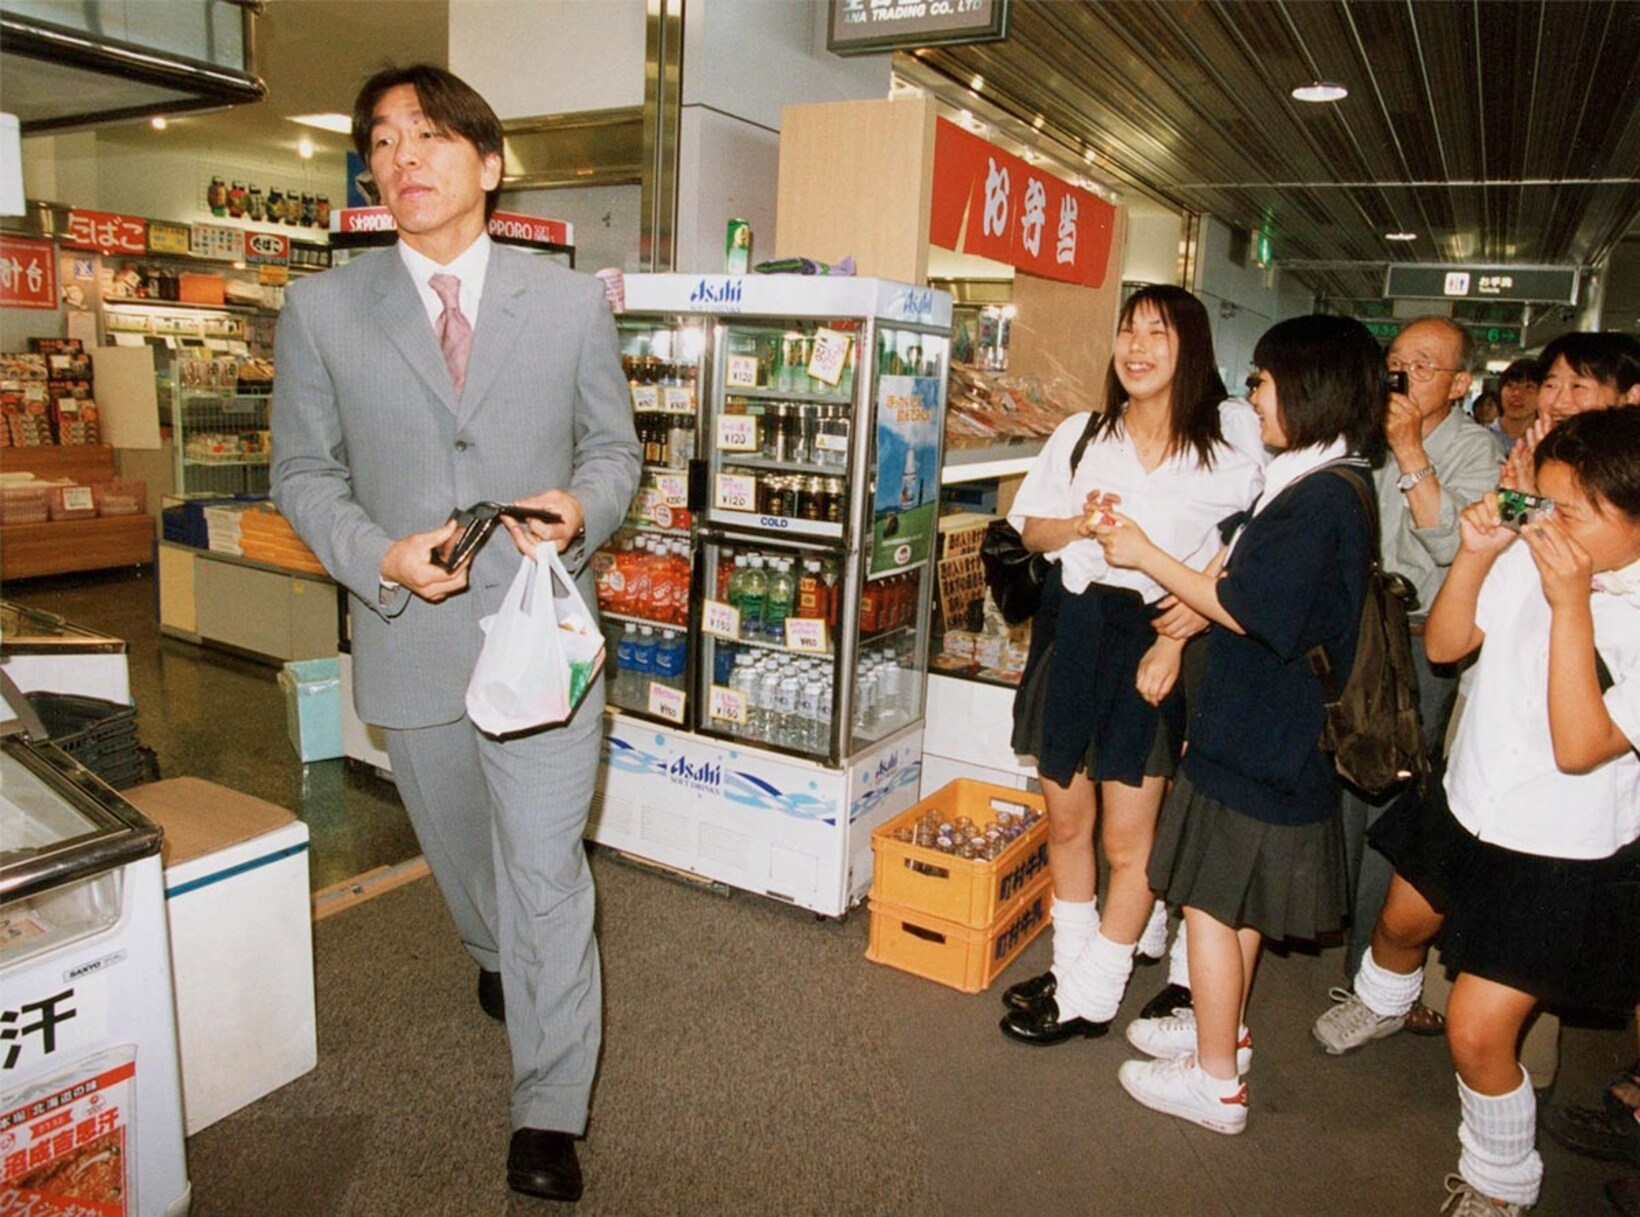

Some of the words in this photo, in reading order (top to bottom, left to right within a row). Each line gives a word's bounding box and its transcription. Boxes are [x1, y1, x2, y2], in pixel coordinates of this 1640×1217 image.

[872, 4, 926, 21] TRADING
[982, 156, 1079, 266] お弁当
[68, 212, 146, 251] たばこ
[252, 236, 282, 253] たばこ
[689, 279, 742, 303] Asahi
[903, 288, 933, 314] Asahi
[725, 433, 746, 445] ¥120
[722, 494, 746, 507] ¥120
[760, 516, 788, 529] COLD
[670, 755, 721, 786] Asahi
[0, 988, 77, 1069] 汗
